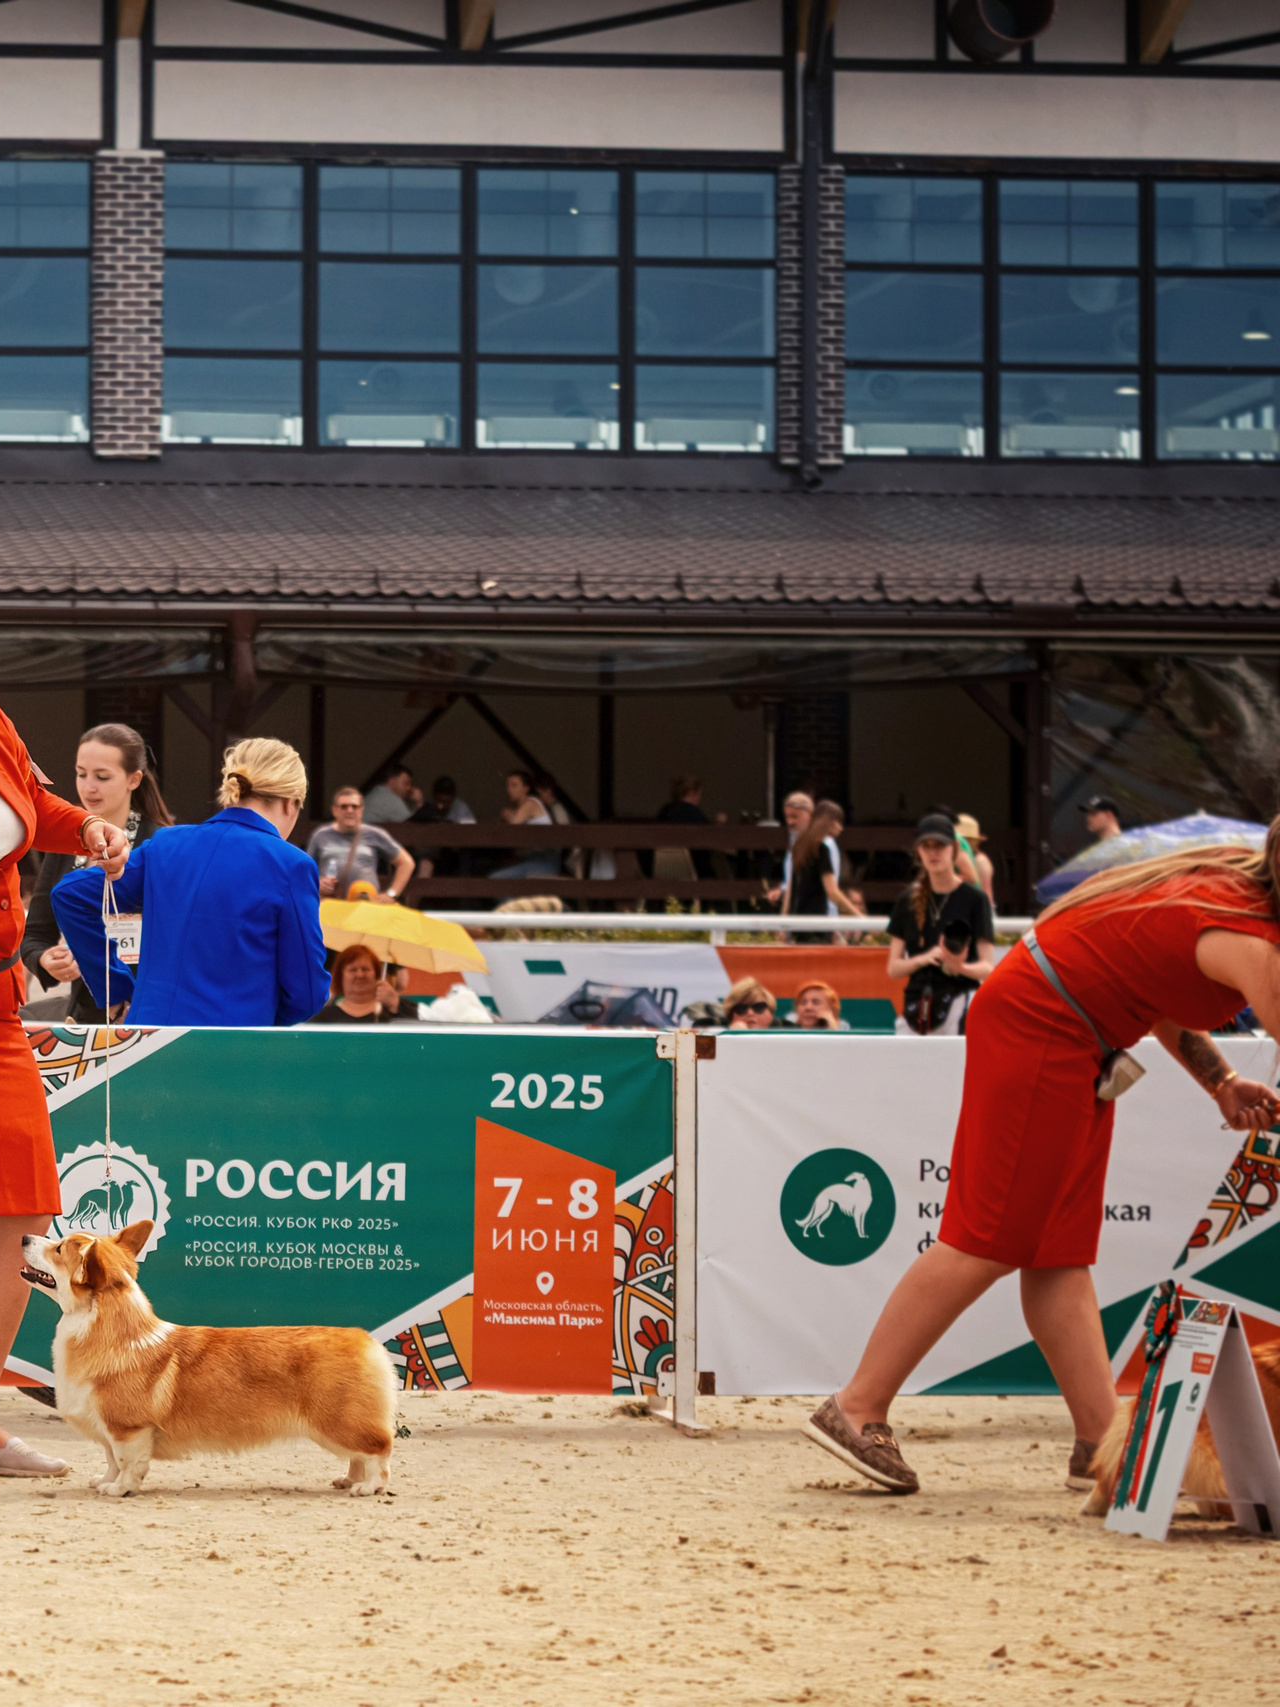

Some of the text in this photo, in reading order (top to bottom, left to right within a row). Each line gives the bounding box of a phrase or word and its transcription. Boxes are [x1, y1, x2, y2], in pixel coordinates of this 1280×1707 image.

[490, 1072, 604, 1111] 2025
[185, 1158, 406, 1201] РОССИЯ
[493, 1177, 523, 1218] 7
[568, 1178, 599, 1220] 8
[185, 1215, 399, 1230] «РОССИЯ. КУБОК РКФ 2025»
[185, 1241, 404, 1256] «РОССИЯ. КУБОК МОСКВЫ &
[492, 1228, 598, 1252] ИЮНЯ
[185, 1255, 420, 1271] КУБОК ГОРОДОВ-ГЕРОЕВ 2025»
[483, 1299, 604, 1313] Московская область,
[484, 1312, 603, 1330] «Максима Парк»
[1136, 1379, 1183, 1513] 1
